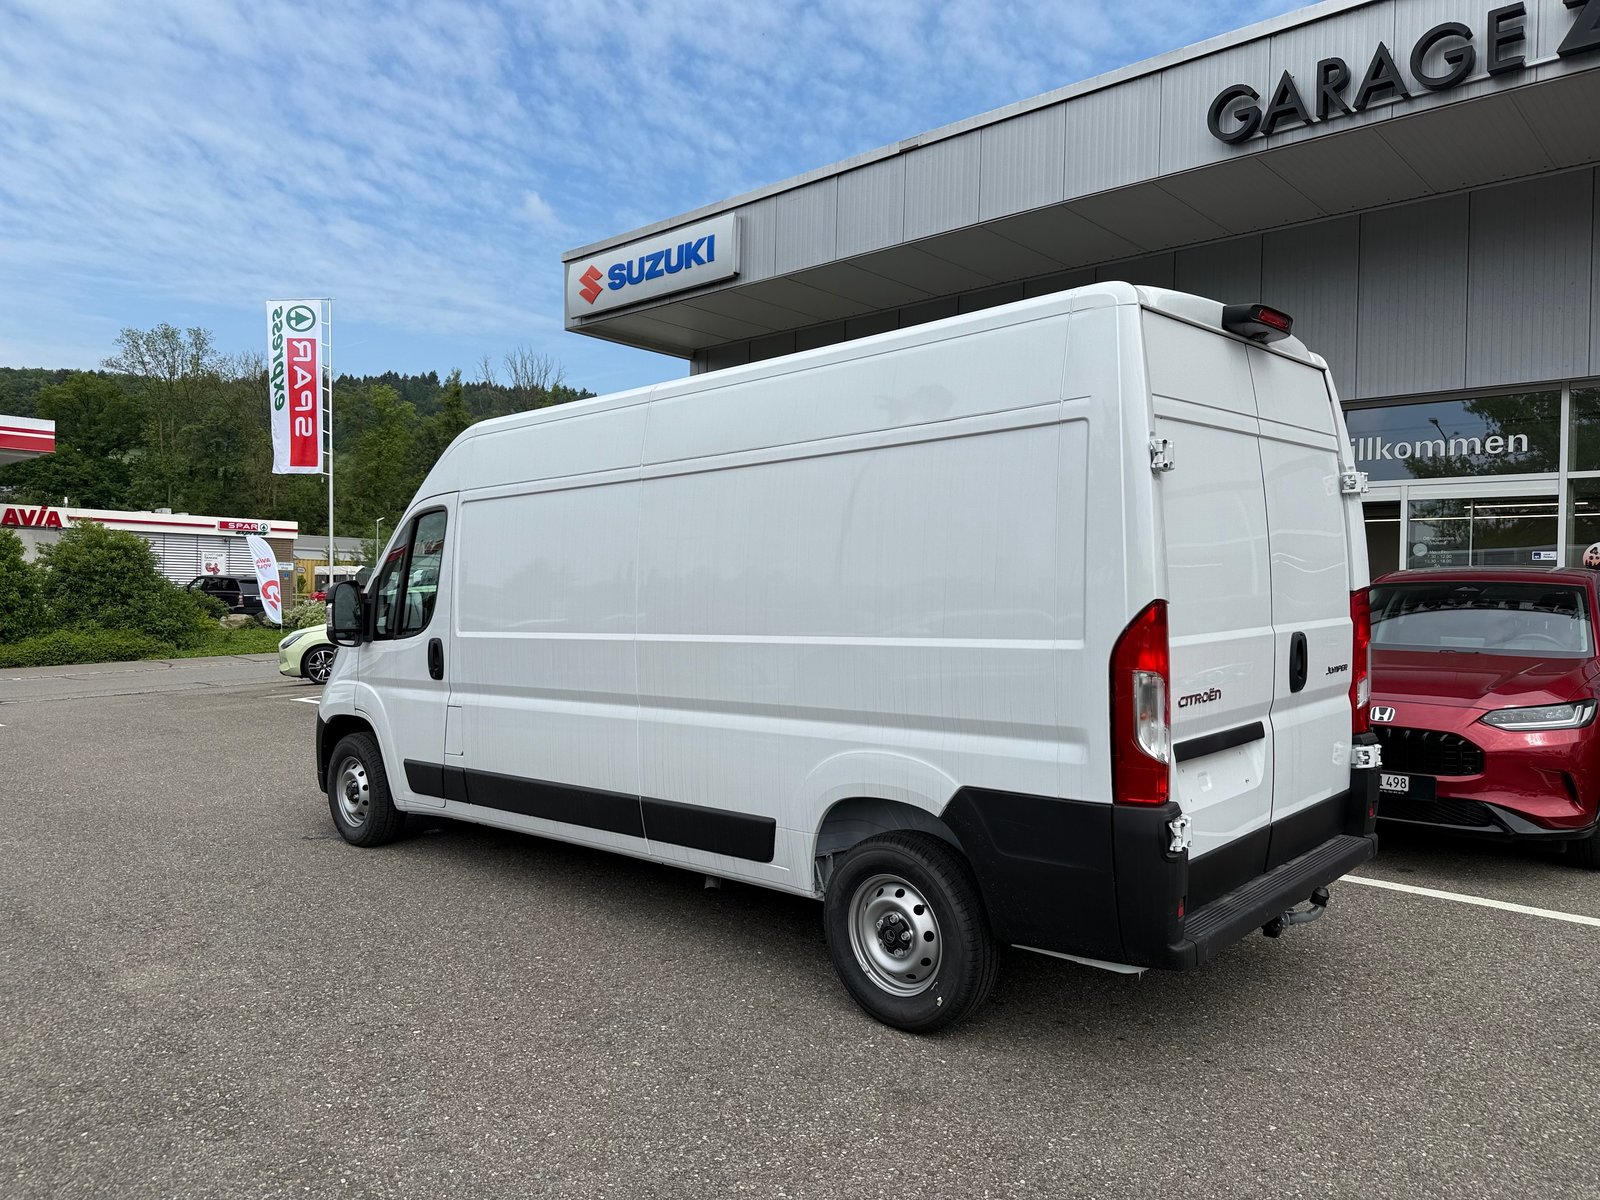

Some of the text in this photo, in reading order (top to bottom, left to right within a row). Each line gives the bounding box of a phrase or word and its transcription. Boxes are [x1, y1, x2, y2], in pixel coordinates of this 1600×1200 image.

[1207, 1, 1526, 144] GARAGE
[607, 234, 715, 291] SUZUKI
[1350, 433, 1528, 461] illkommen
[1, 505, 63, 528] AVIA
[228, 522, 258, 530] SPAR
[1386, 776, 1407, 789] 498
